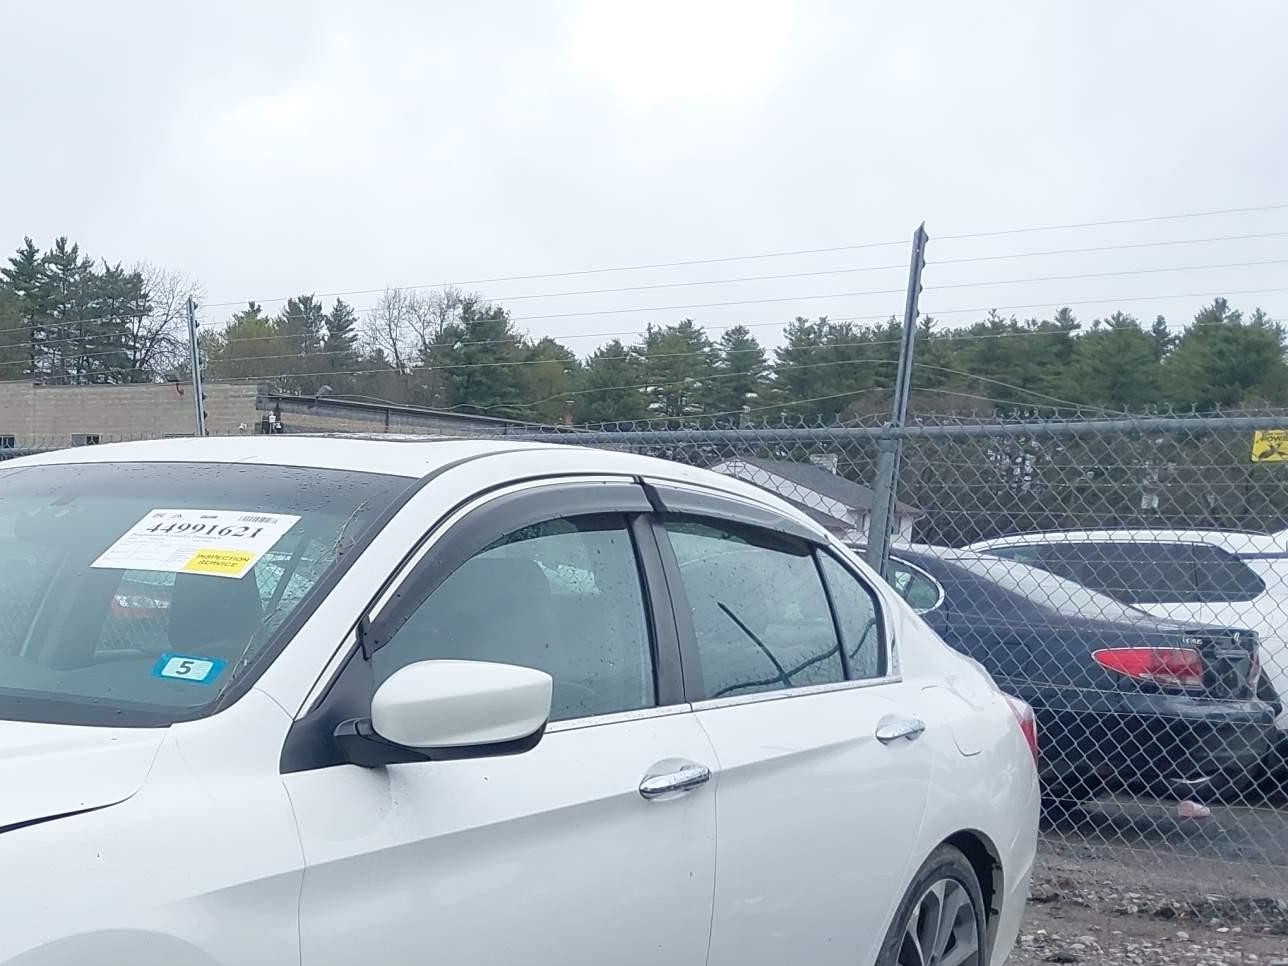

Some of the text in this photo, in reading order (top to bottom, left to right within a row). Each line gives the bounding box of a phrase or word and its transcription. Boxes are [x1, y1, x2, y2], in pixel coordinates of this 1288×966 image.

[147, 522, 264, 539] 44991621
[197, 553, 250, 562] INSPECTION
[198, 560, 238, 568] SERVICE
[175, 661, 195, 676] 5
